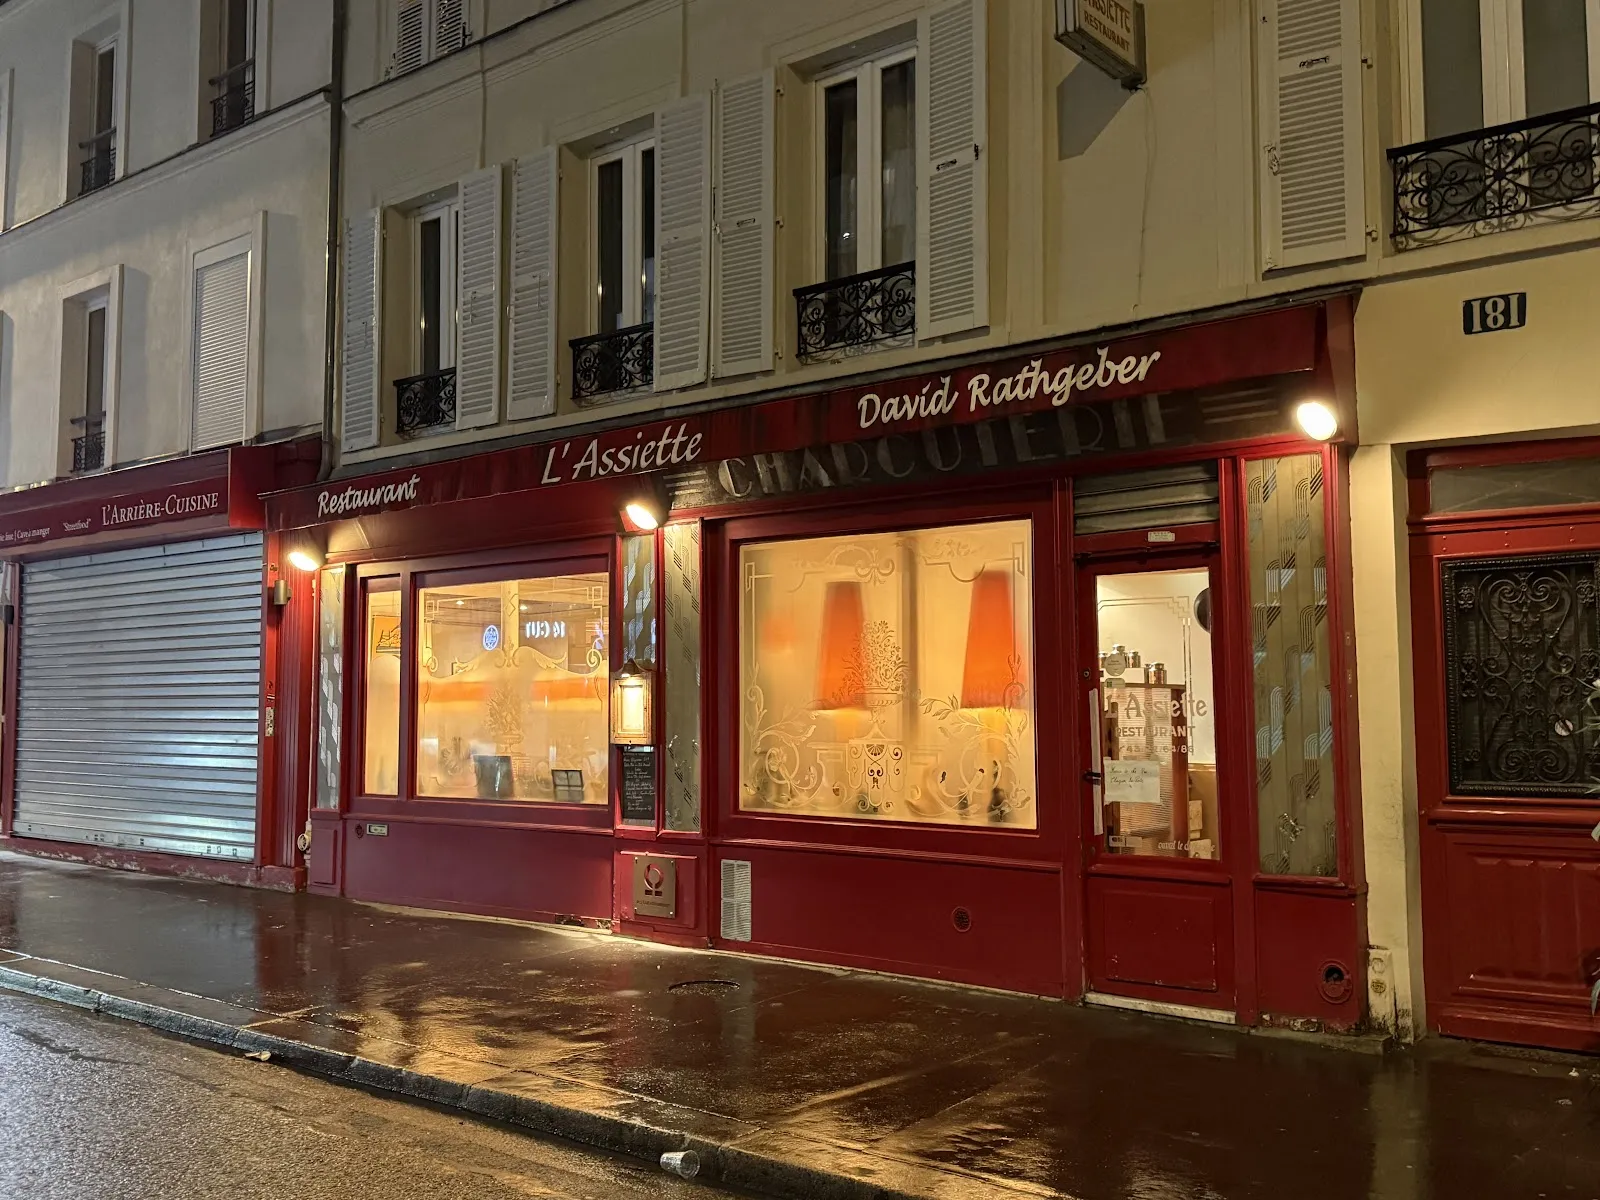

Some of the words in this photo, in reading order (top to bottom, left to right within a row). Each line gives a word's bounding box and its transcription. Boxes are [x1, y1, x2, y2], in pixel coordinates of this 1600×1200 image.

[1084, 10, 1130, 52] RESTAURANT
[1471, 294, 1520, 332] 181
[858, 375, 958, 429] David
[967, 347, 1161, 407] Rathgeber
[541, 422, 703, 485] L'Assiette
[317, 473, 421, 518] Restaurant
